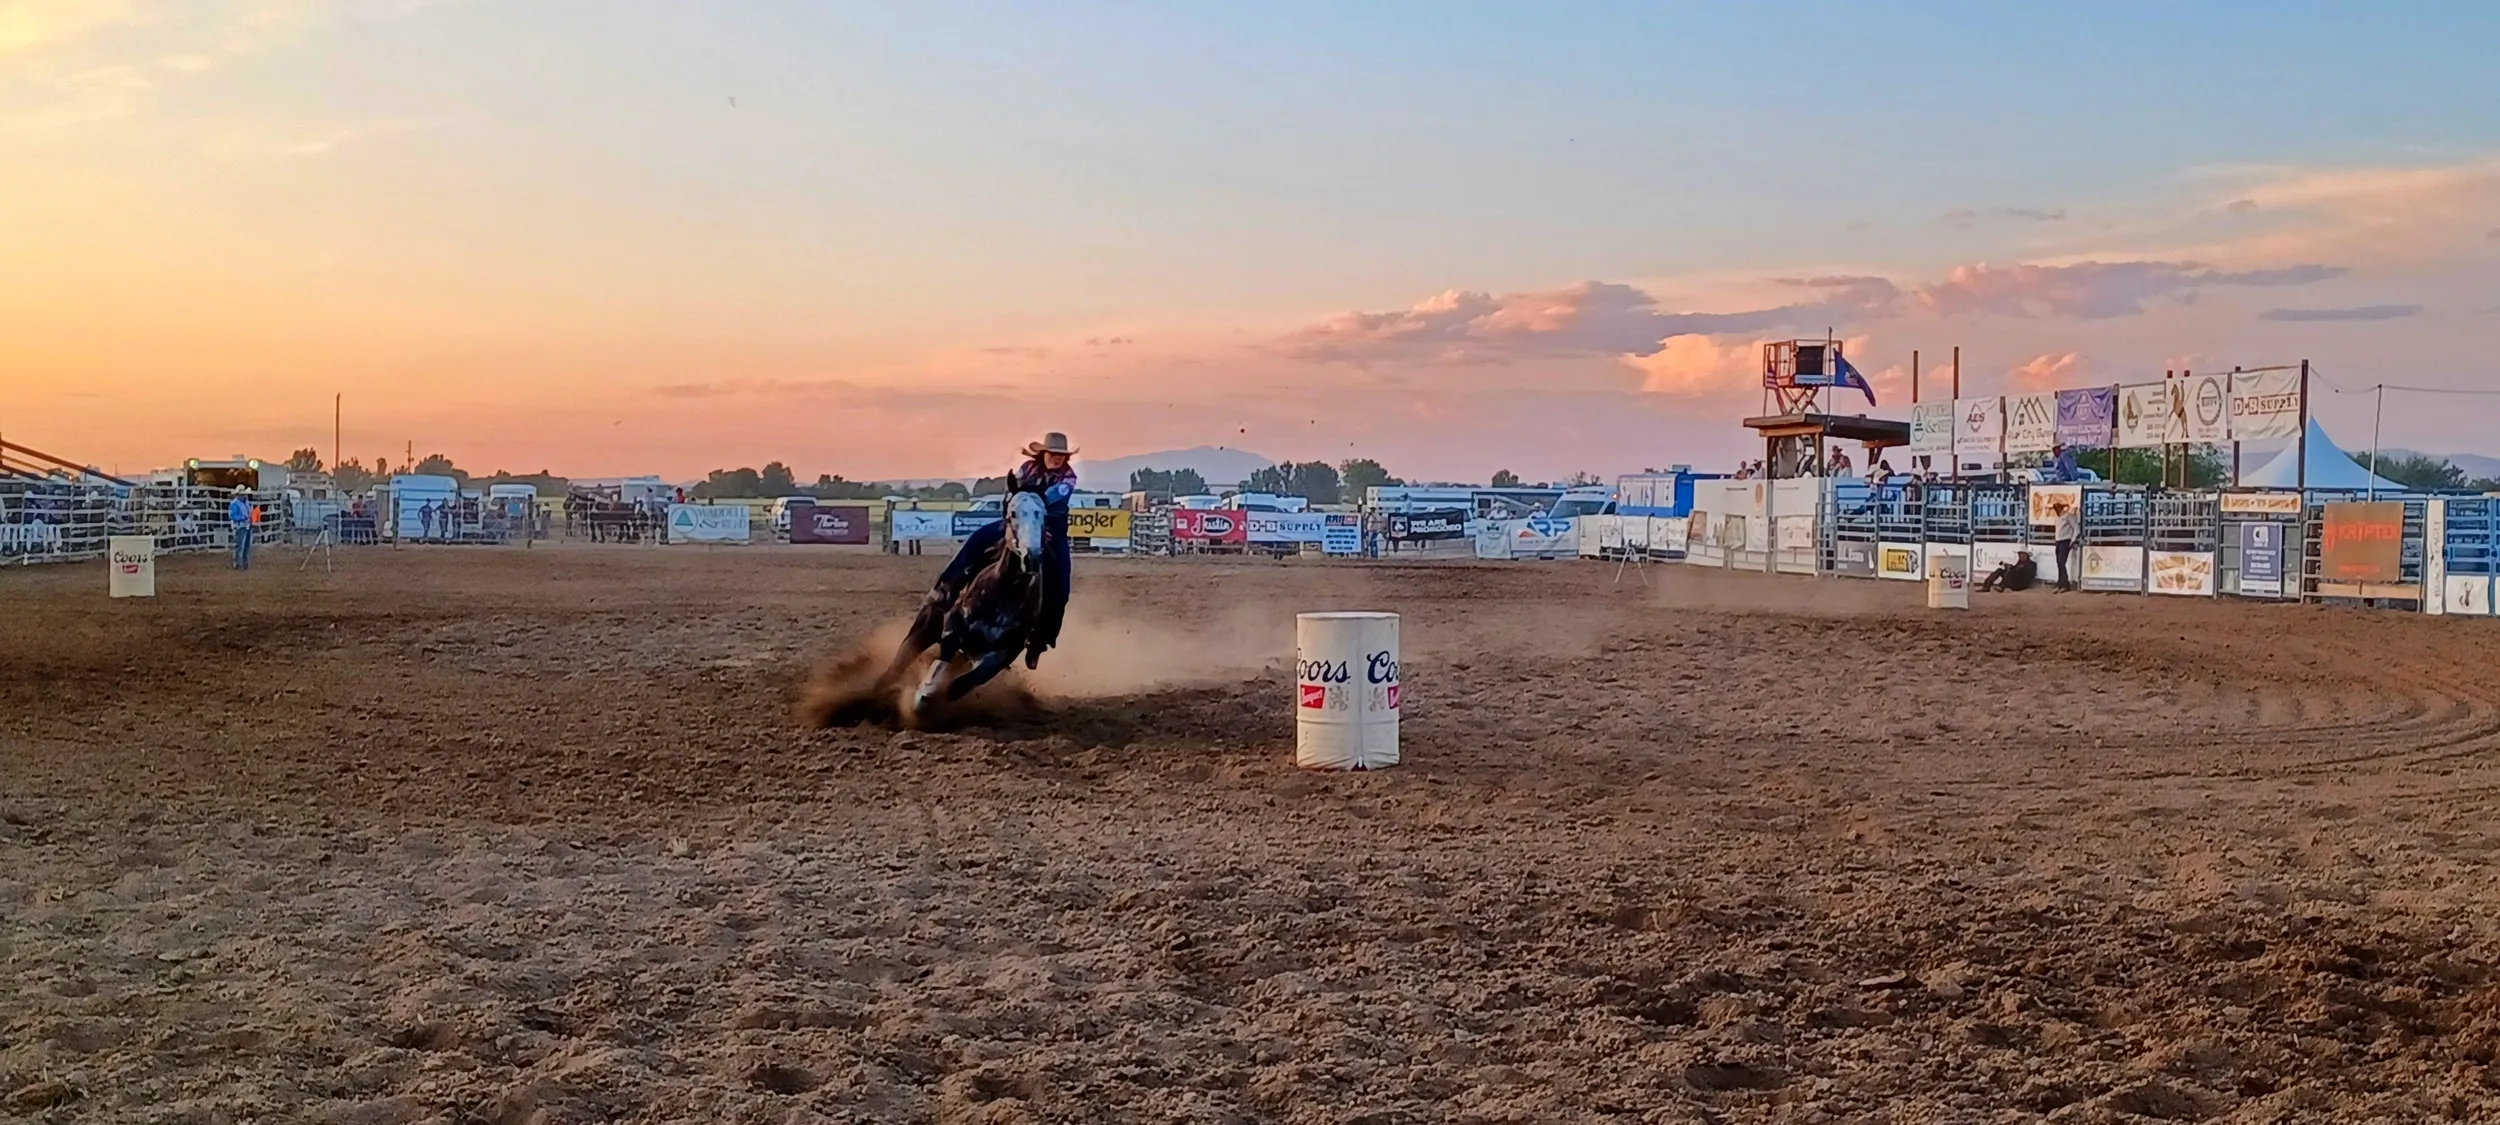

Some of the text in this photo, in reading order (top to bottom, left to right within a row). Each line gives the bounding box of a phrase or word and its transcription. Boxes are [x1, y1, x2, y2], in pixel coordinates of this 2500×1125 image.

[1068, 512, 1117, 534] angler
[1191, 512, 1232, 536] Justin
[1279, 522, 1322, 531] SUPPLY
[113, 550, 148, 563] Coors
[1297, 648, 1351, 683] oors
